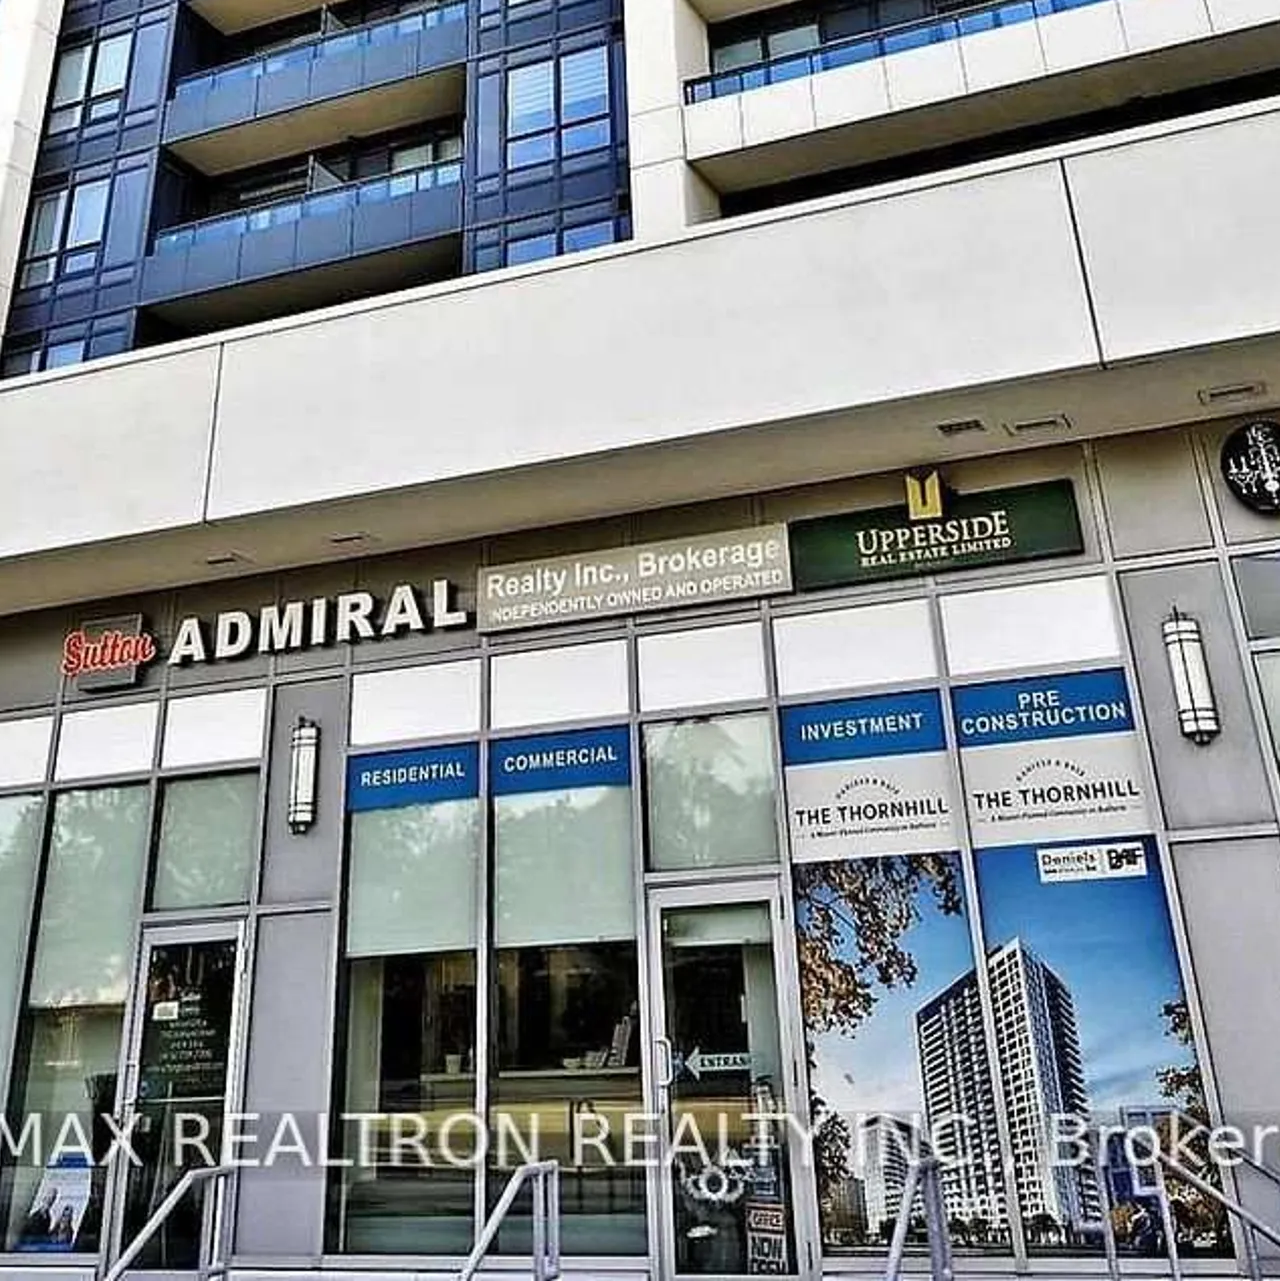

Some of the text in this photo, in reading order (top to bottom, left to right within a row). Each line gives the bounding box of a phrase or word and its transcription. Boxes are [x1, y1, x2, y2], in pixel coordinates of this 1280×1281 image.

[856, 510, 1010, 555] UPPERSIDE
[860, 536, 1012, 568] REAL ESTATE LIMITED
[486, 538, 781, 599] Realty Inc., Brokerage
[607, 586, 662, 609] OWNED
[665, 581, 699, 601] AND
[703, 568, 785, 595] OPERATED
[168, 578, 469, 665] ADMIRAL
[61, 628, 157, 678] Sutton
[1017, 689, 1060, 710] PRE
[801, 712, 924, 742] INVESTMENT
[962, 702, 1126, 736] CONSTRUCTION
[360, 761, 466, 788] RESIDENTIAL
[503, 745, 618, 773] COMMERCIAL
[972, 779, 1140, 810] THE THORNHILL
[795, 797, 949, 827] THE THORNHILL
